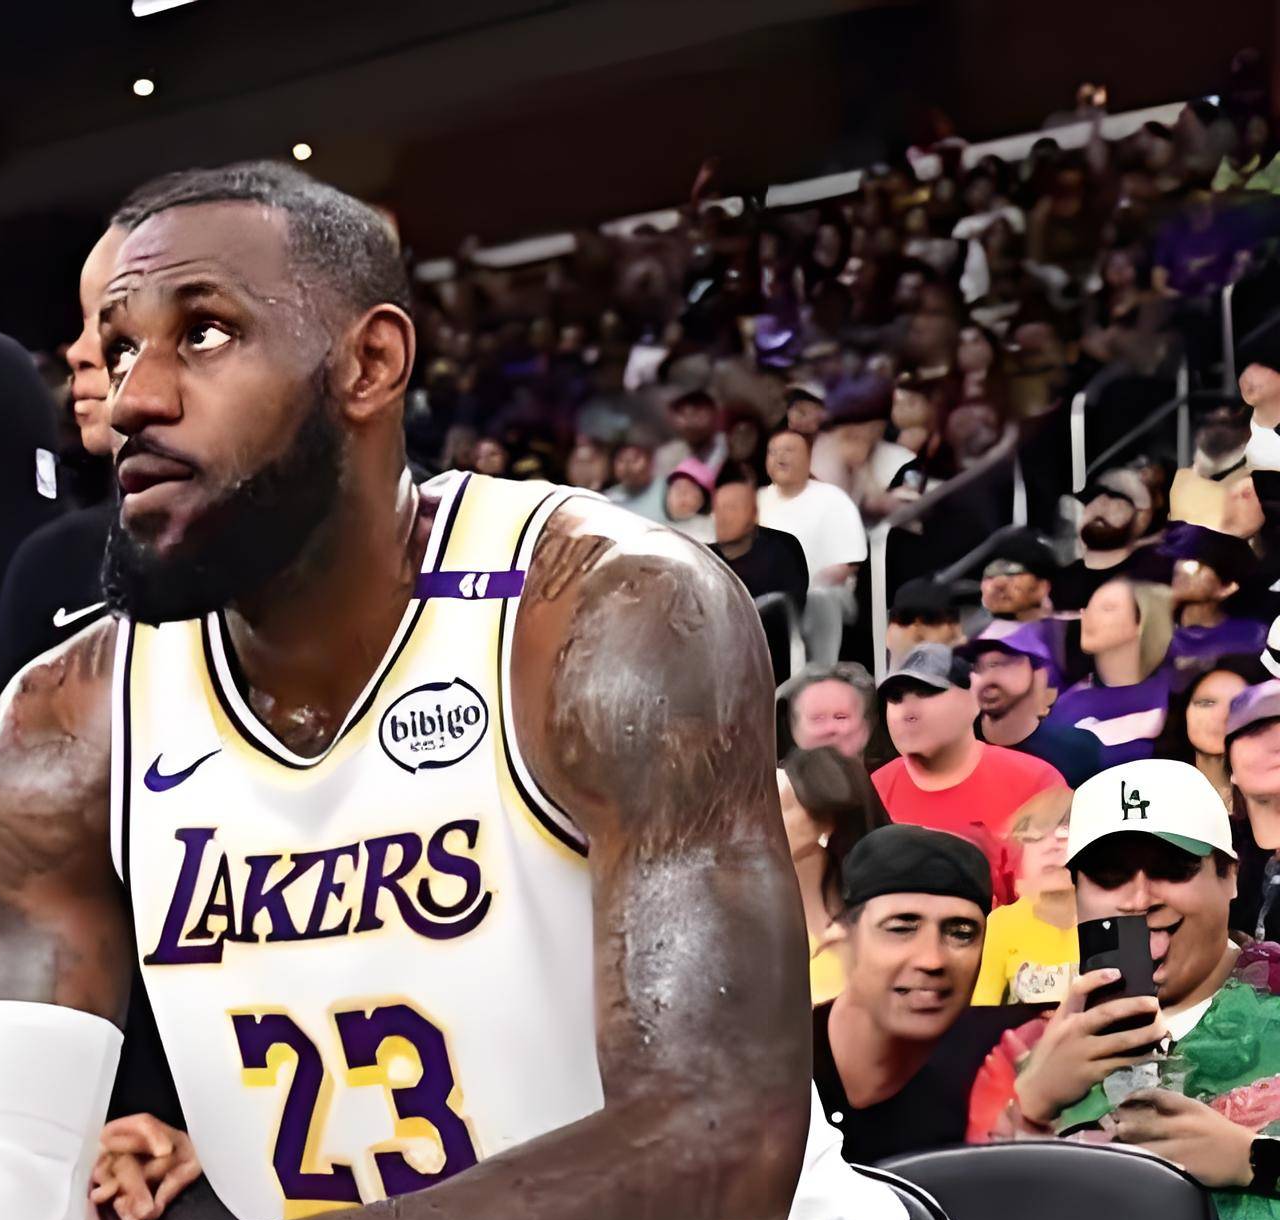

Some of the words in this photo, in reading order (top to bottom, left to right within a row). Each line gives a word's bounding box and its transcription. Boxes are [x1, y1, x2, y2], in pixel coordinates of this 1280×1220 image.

[390, 704, 481, 743] bibigo
[143, 819, 494, 966] LAKERS
[228, 1001, 480, 1206] 23
